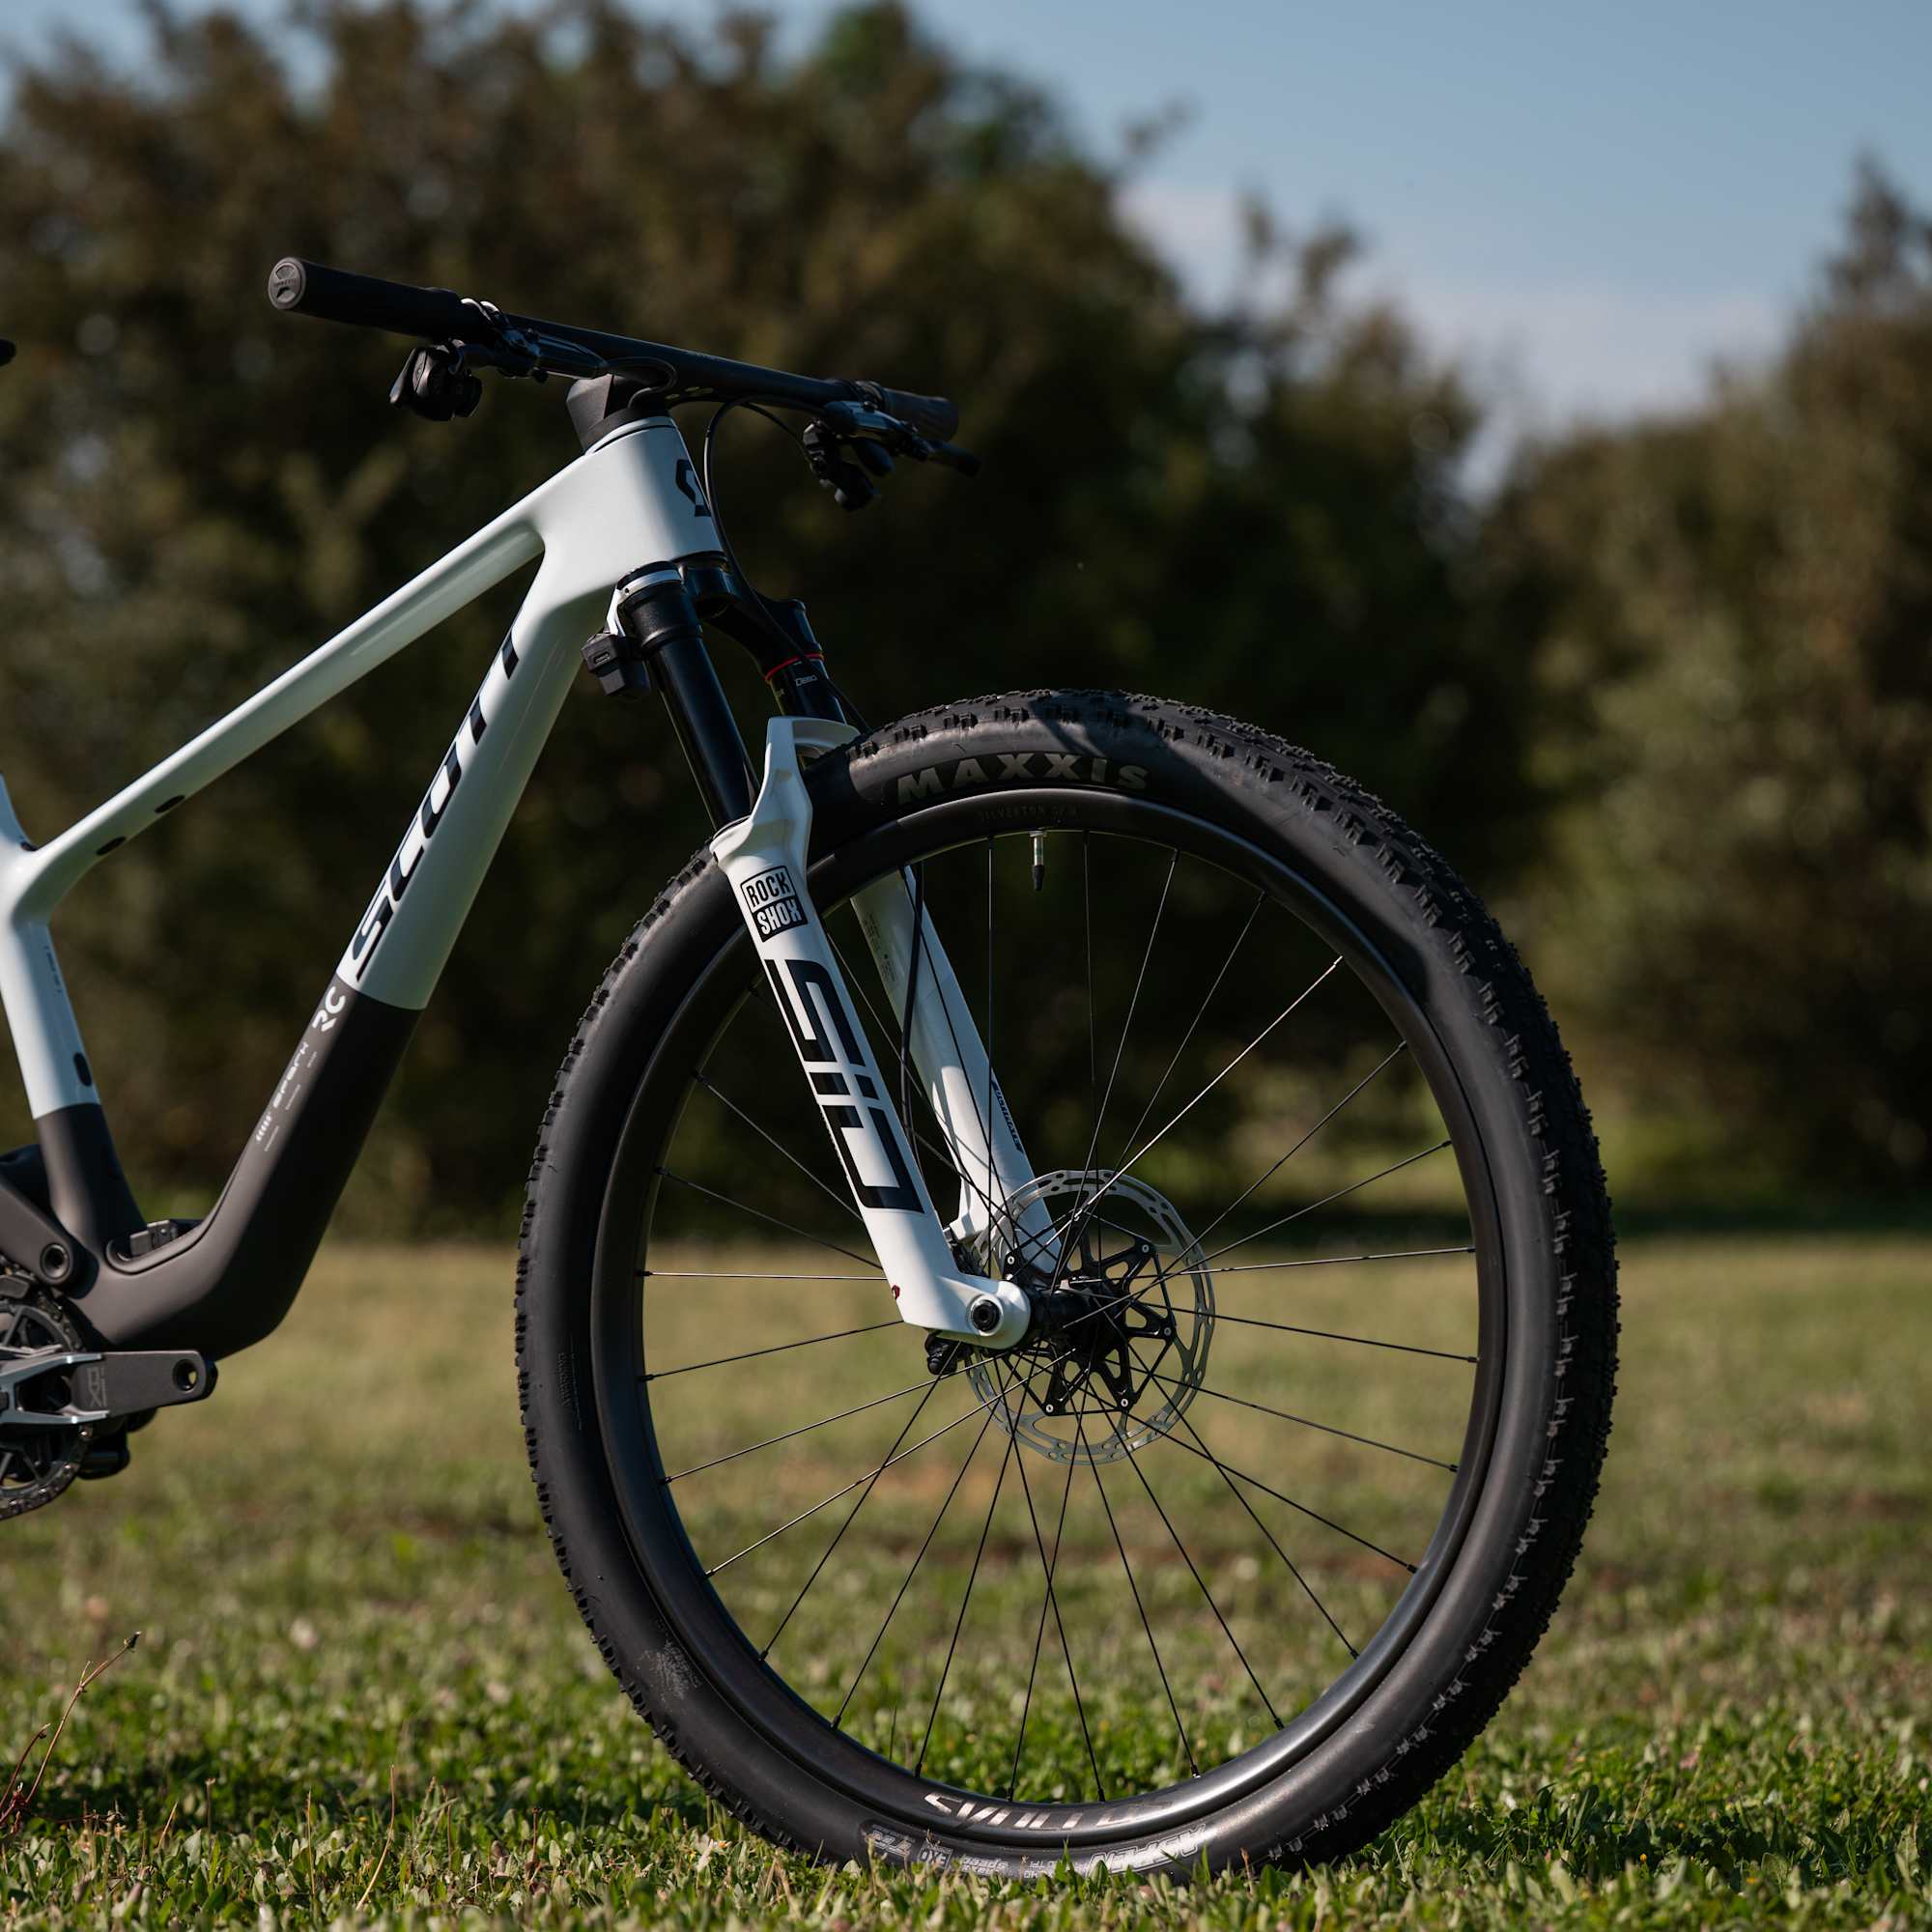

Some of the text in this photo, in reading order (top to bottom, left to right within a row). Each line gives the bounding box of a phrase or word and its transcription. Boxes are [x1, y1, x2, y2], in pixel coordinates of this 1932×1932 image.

[897, 753, 1150, 806] MAXXIS
[746, 871, 791, 908] ROCK
[756, 897, 803, 935] SHOX
[311, 985, 347, 1033] RC
